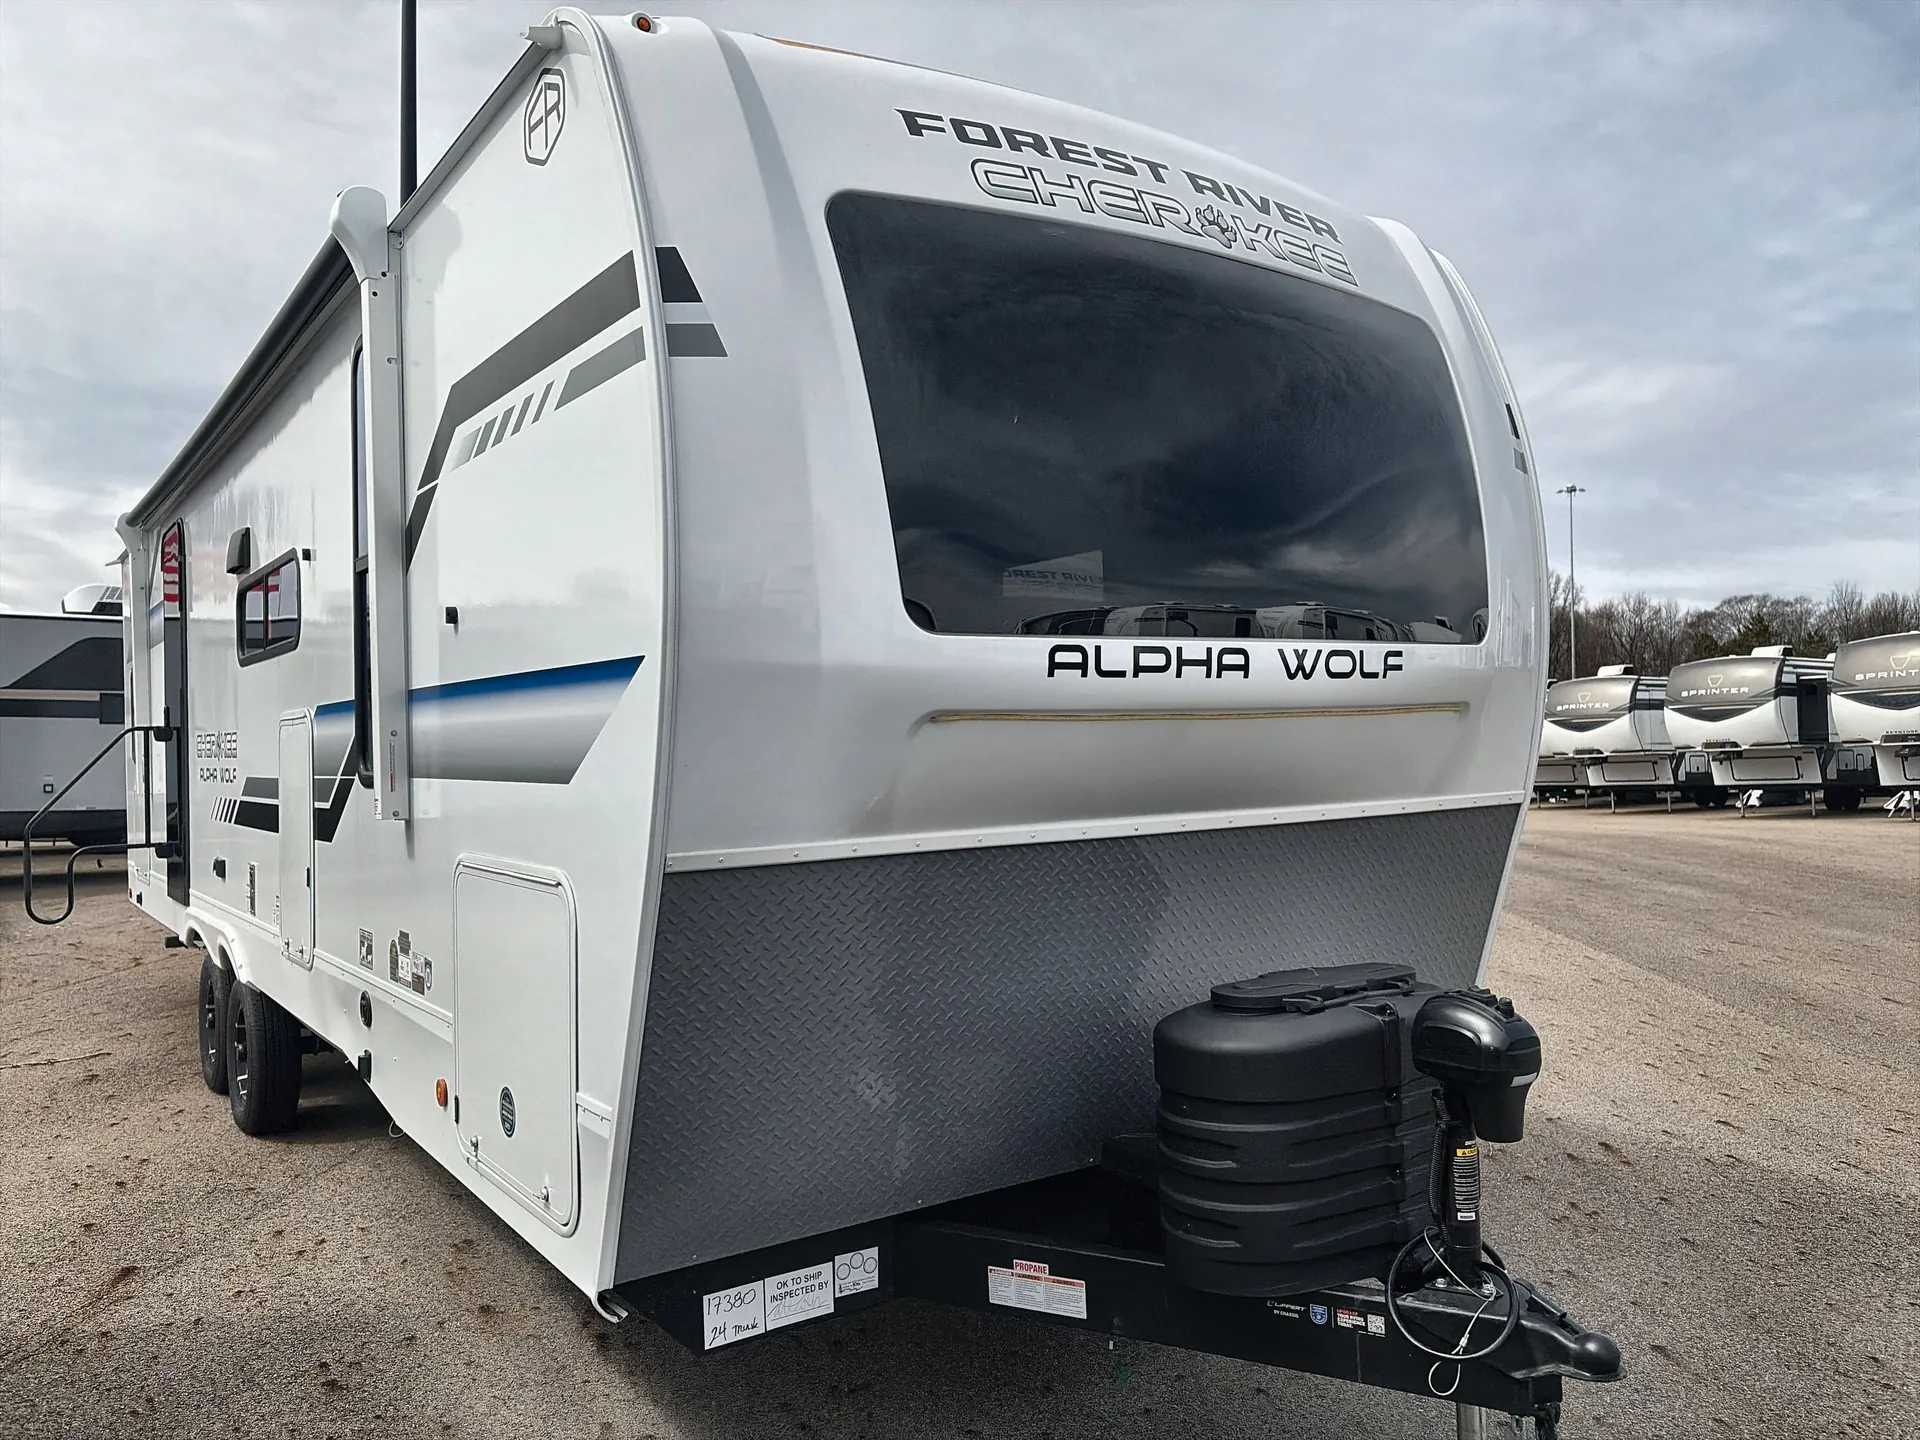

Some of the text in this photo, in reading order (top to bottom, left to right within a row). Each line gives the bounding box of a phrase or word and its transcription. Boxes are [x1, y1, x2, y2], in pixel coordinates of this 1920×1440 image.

[894, 108, 1345, 246] FOREST RIVER
[1046, 644, 1404, 681] ALPHA WOLF
[1681, 686, 1749, 698] SPRINTER
[1556, 702, 1610, 712] SPRINTER
[200, 767, 236, 783] ALPHA WOLF
[1015, 1261, 1047, 1274] PROPANE
[776, 1270, 823, 1291] OK TO SHIP
[707, 1288, 757, 1316] 17380
[770, 1285, 816, 1304] INSPECTED
[818, 1281, 829, 1293] BY
